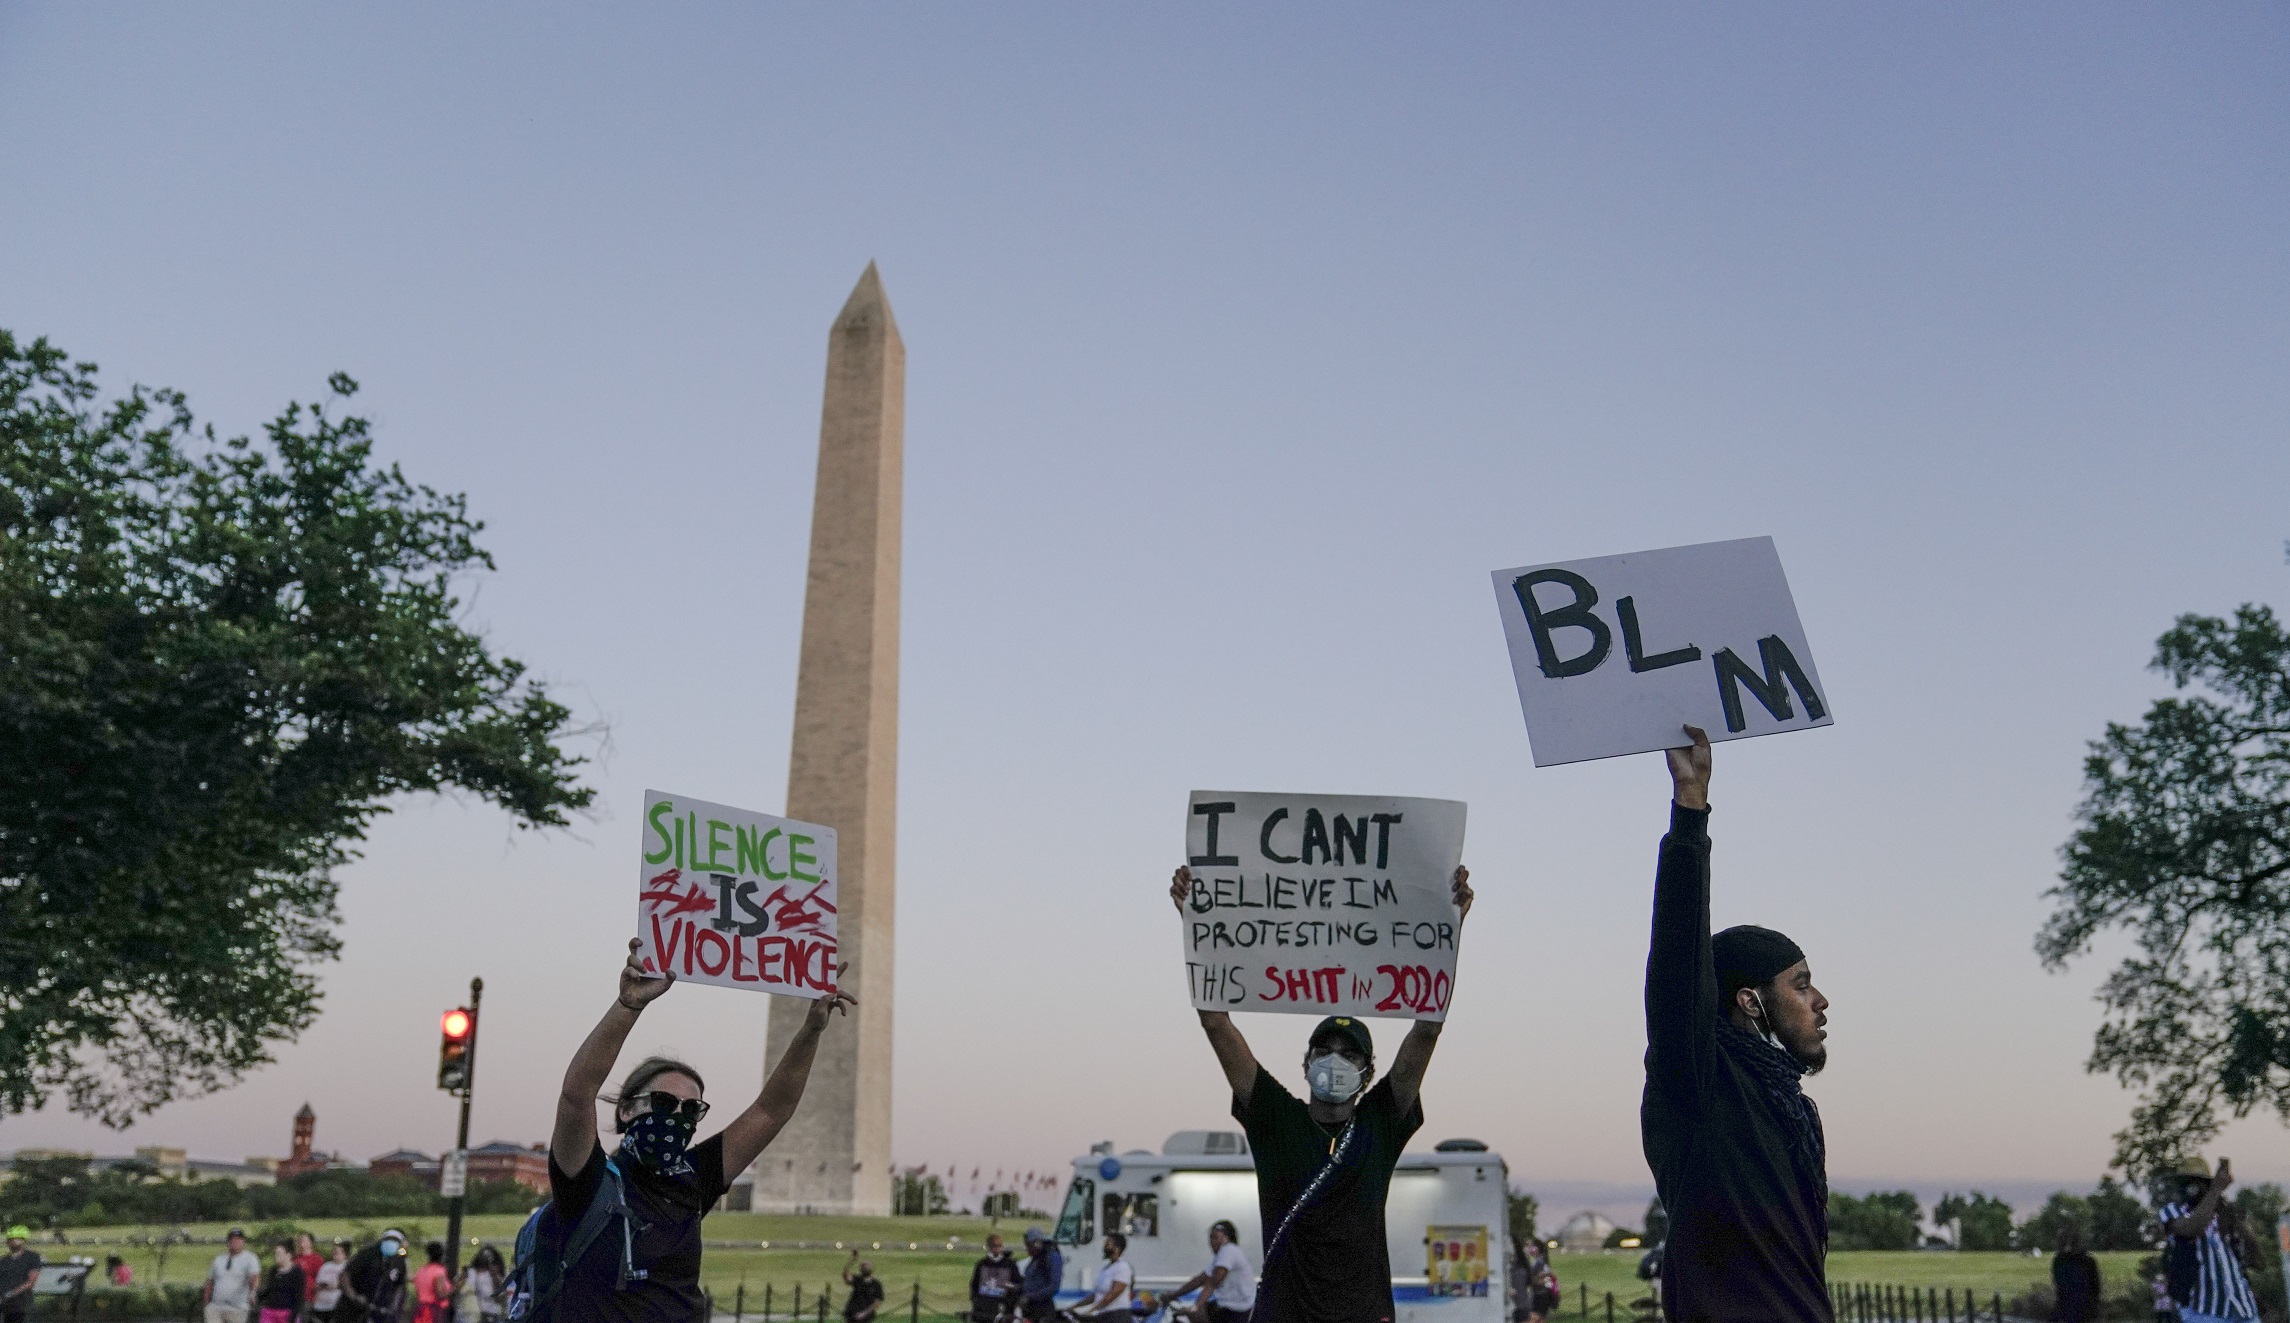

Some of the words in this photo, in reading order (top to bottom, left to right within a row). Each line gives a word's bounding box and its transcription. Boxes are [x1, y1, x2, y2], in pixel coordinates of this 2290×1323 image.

[644, 801, 820, 883] SILENCE
[1190, 802, 1239, 867] I
[1260, 807, 1403, 869] CANT
[710, 873, 769, 937] IS
[1190, 873, 1336, 914] BELIEVE
[1342, 876, 1398, 909] IM
[651, 913, 837, 993] VIOLENCE
[1192, 920, 1378, 952] PROTESTING
[1393, 921, 1454, 951] FOR
[1186, 962, 1246, 1004] THIS
[1259, 965, 1346, 1004] SHIT
[1352, 972, 1373, 1001] IN
[1375, 964, 1450, 1013] 2020
